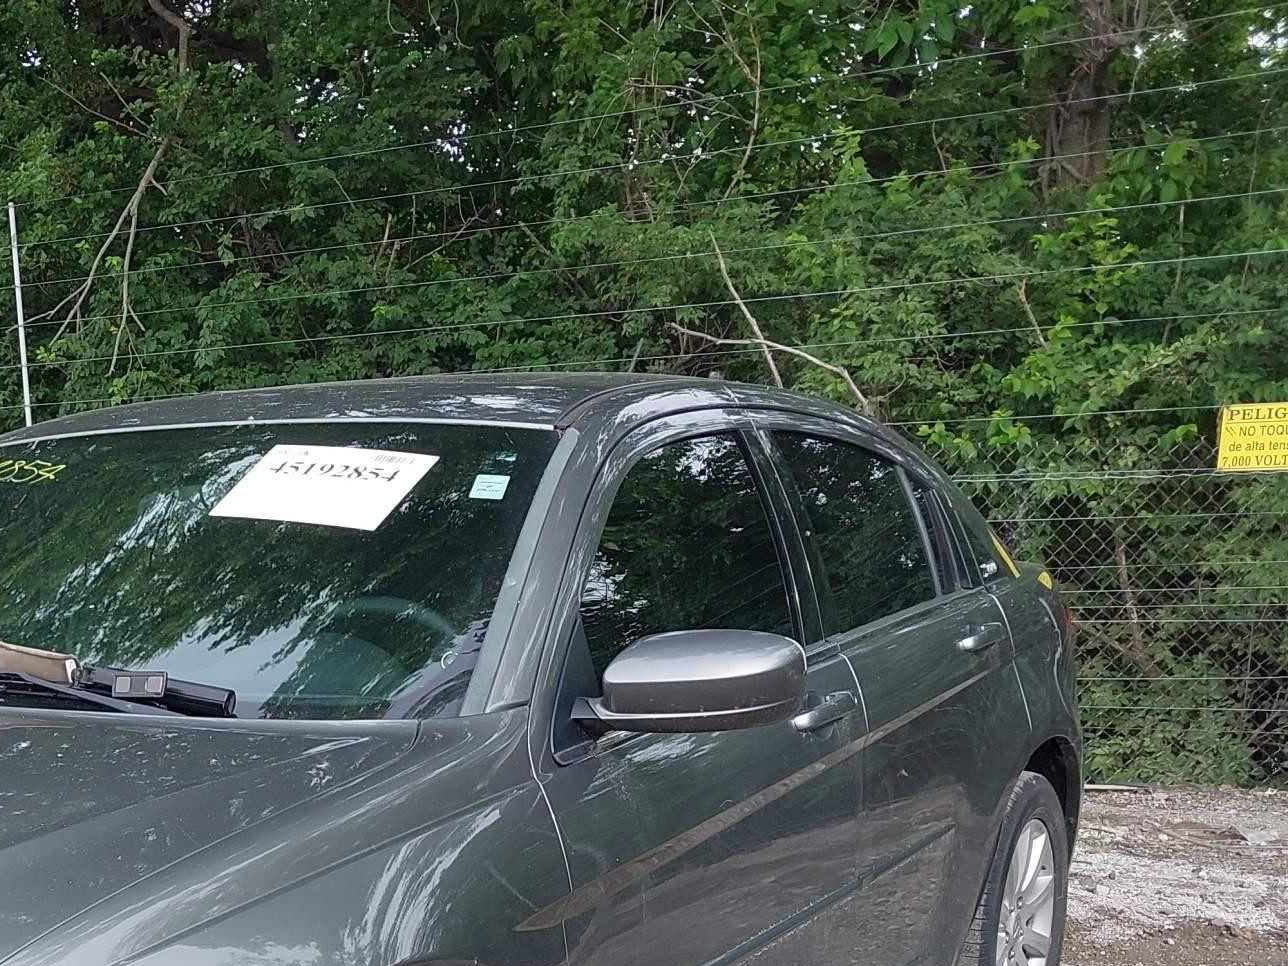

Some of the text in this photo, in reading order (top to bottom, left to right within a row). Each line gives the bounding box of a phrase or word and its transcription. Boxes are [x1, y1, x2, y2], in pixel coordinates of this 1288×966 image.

[1238, 424, 1288, 437] NO TOQ
[1228, 441, 1242, 452] de
[1245, 440, 1265, 452] alta
[269, 460, 402, 483] 45192854
